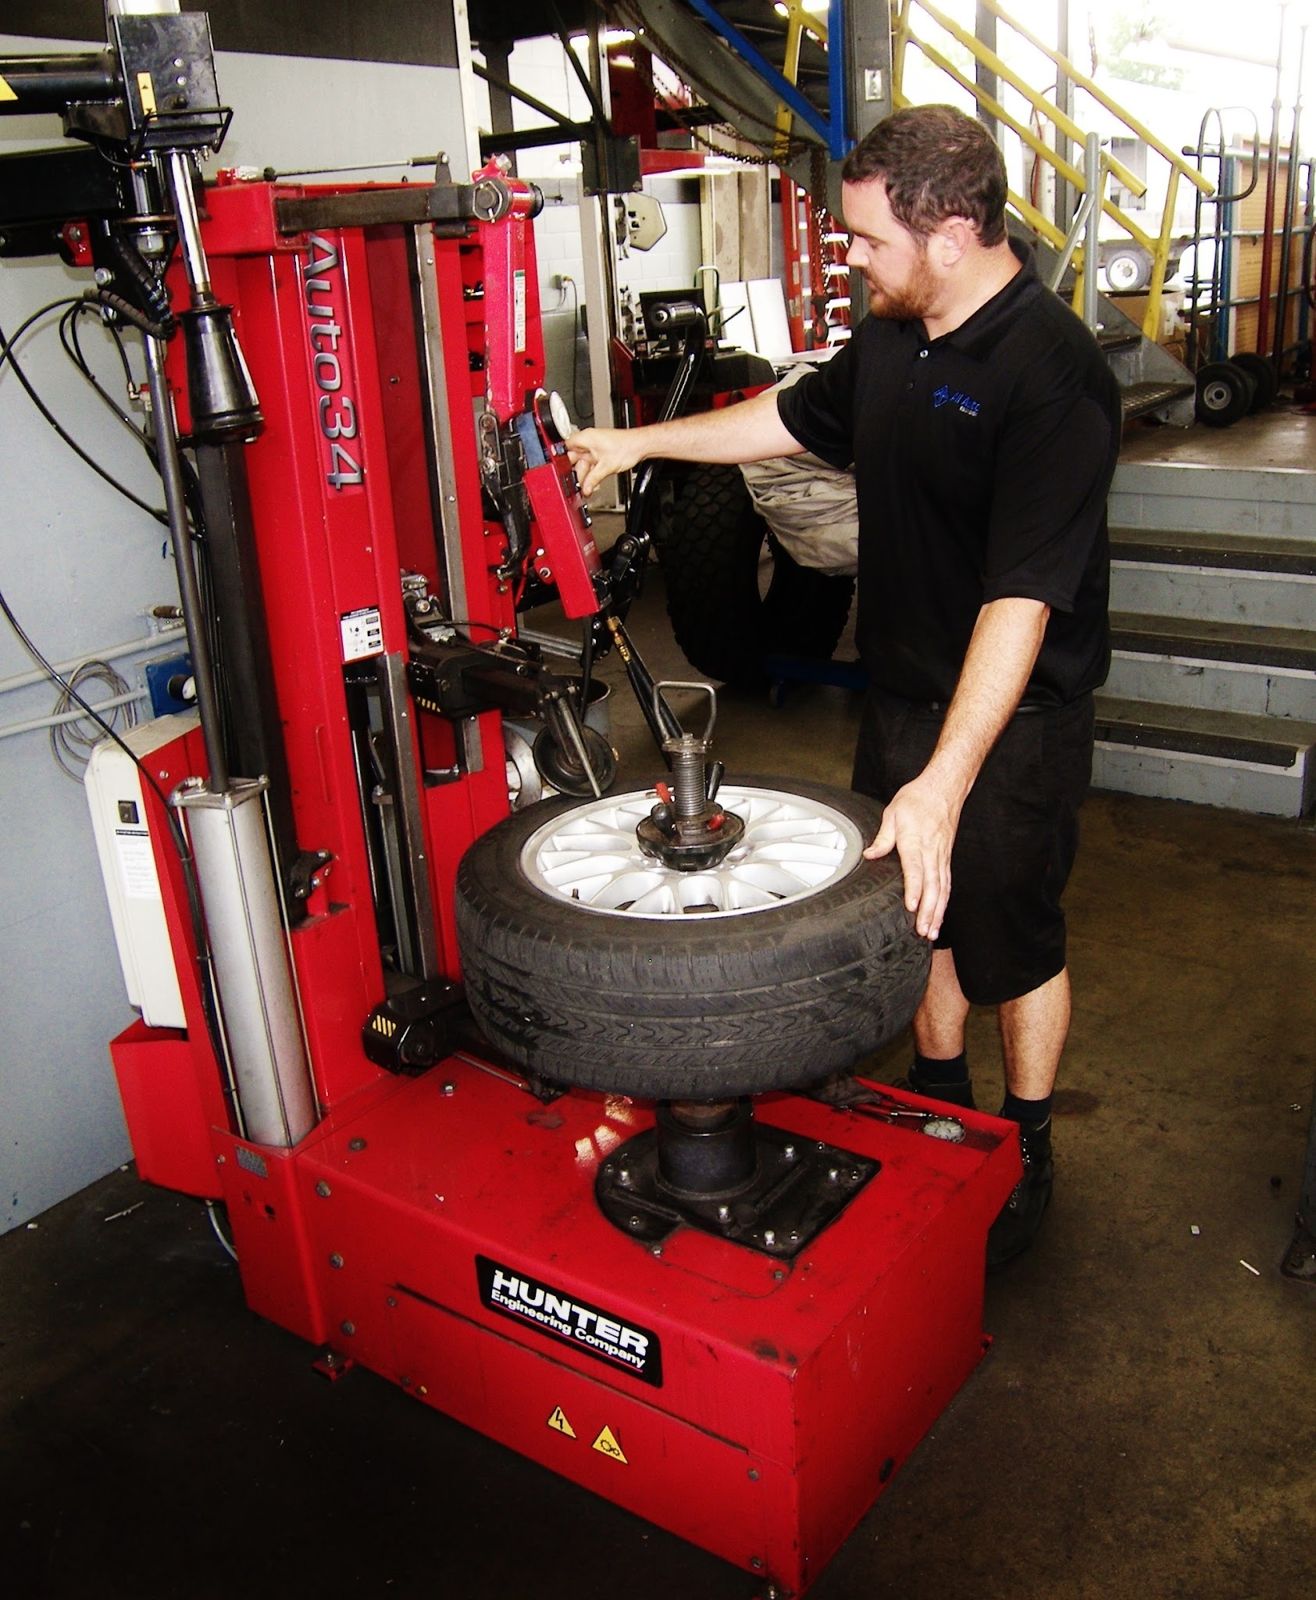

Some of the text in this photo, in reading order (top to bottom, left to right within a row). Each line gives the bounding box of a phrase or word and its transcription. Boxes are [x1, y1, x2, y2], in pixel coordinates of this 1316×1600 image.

[303, 234, 364, 490] Auto34
[491, 1288, 646, 1369] Engineering Company
[492, 1269, 649, 1357] HUNTER
